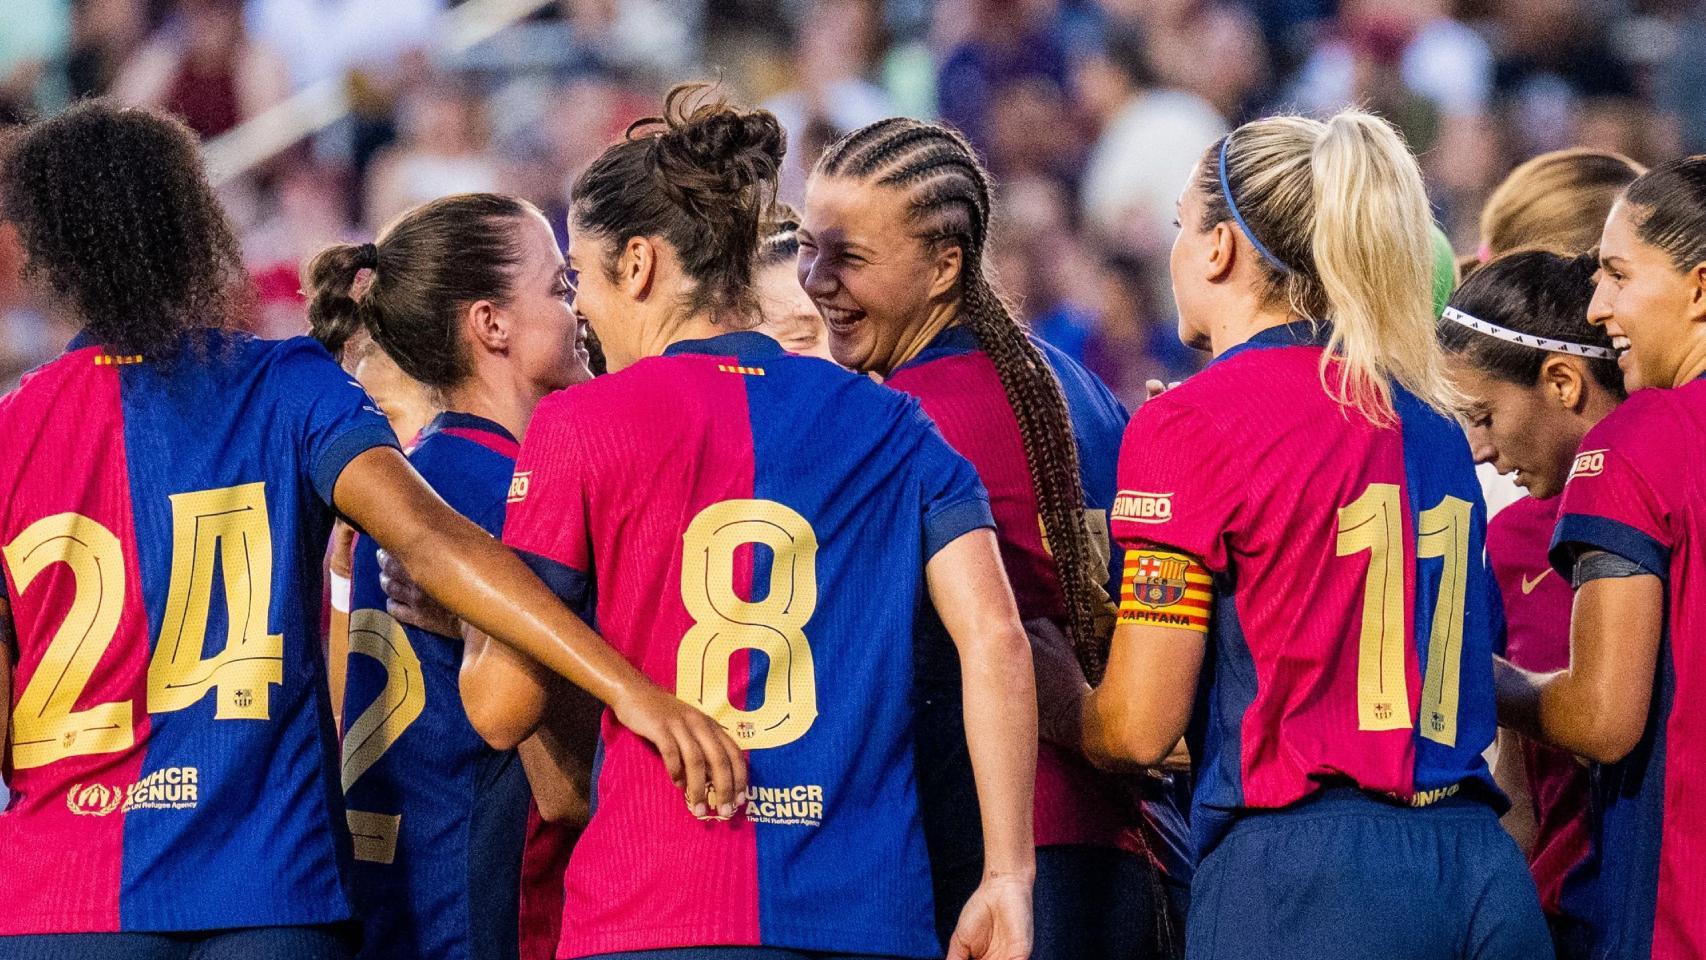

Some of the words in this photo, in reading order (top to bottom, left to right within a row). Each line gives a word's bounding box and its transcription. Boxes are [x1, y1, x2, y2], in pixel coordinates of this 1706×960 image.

[1111, 497, 1171, 518] BIMBO
[2, 481, 283, 769] 24
[676, 499, 819, 750] 8
[1122, 611, 1190, 626] CAPITANA
[1336, 483, 1473, 748] 11
[341, 608, 426, 864] 2
[126, 767, 198, 796] UNHCR
[123, 784, 198, 807] ACNUR
[745, 785, 823, 802] UNHCR
[142, 802, 171, 810] Refugee
[172, 802, 197, 810] Agency
[745, 801, 823, 819] ACNUR
[771, 818, 800, 826] Refugee
